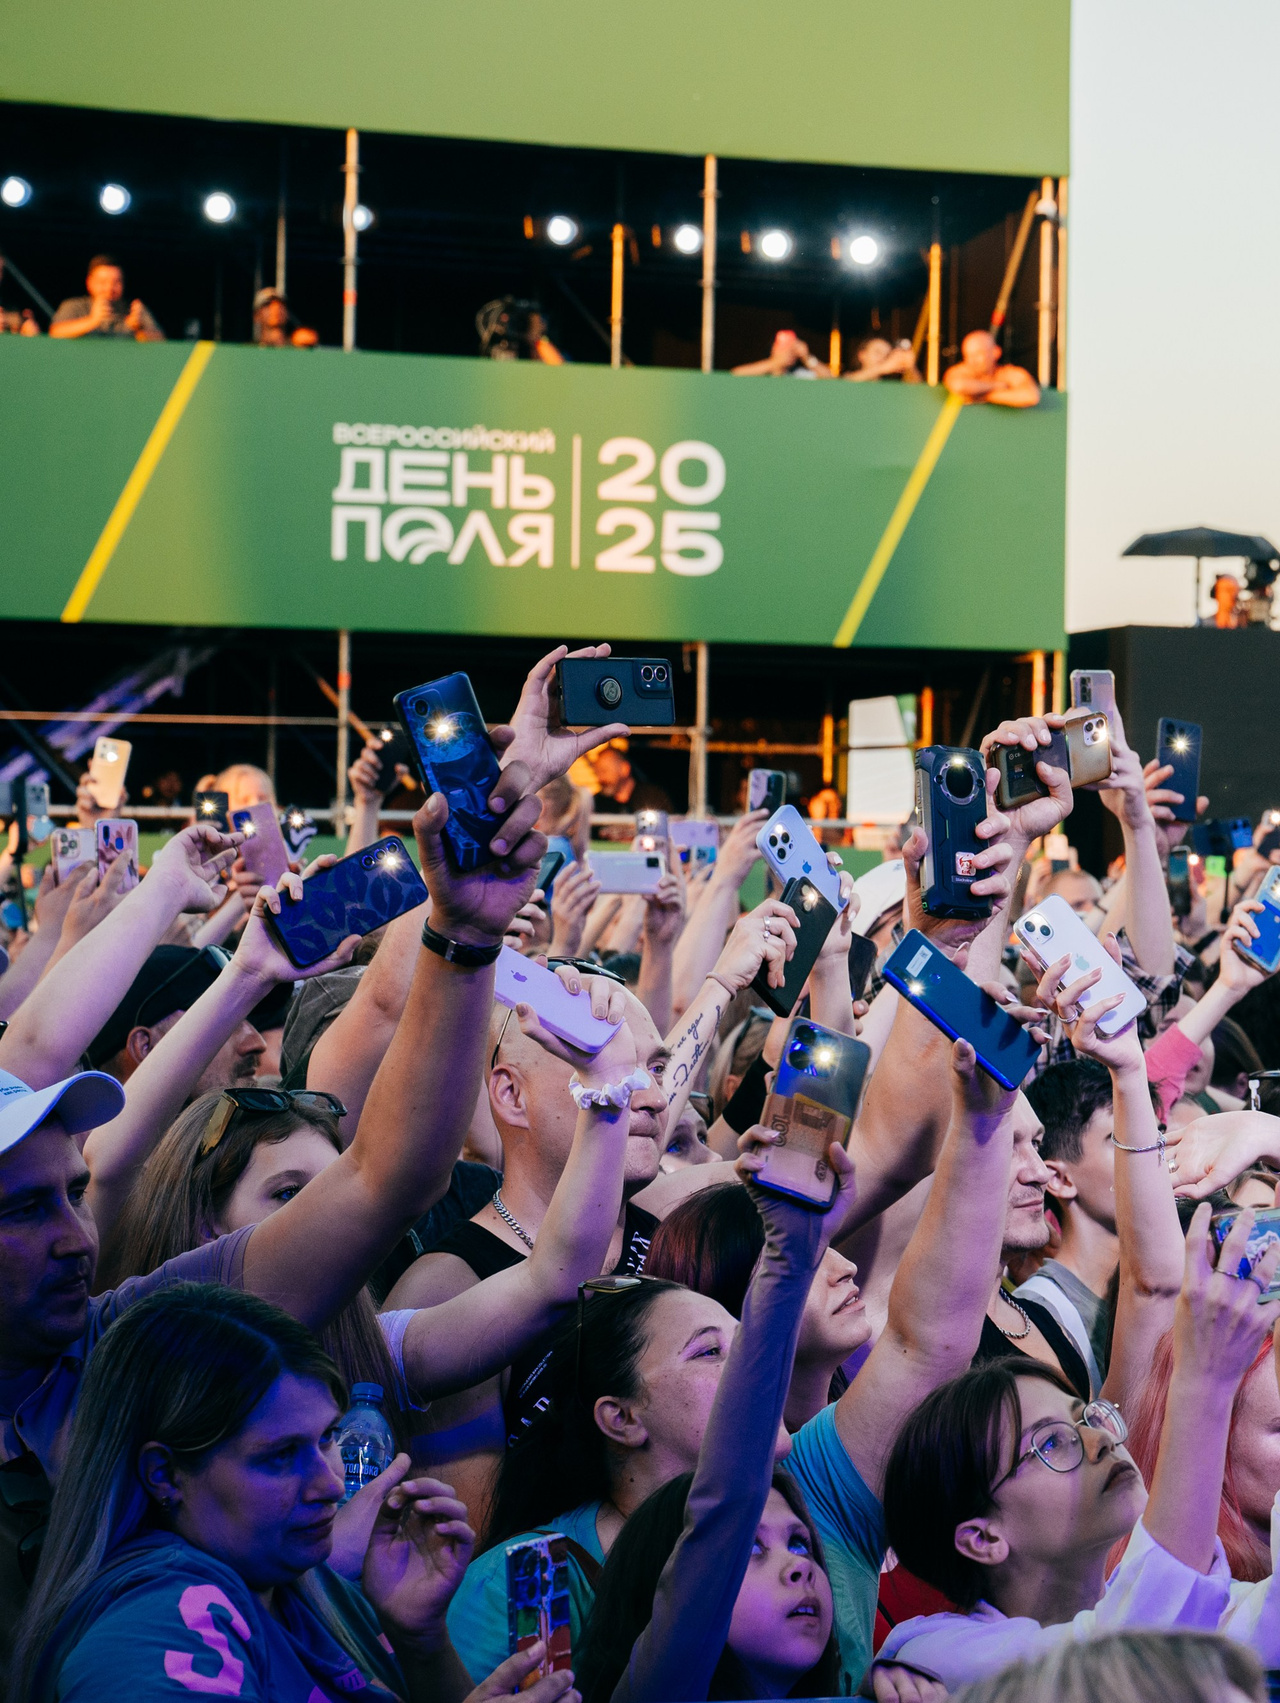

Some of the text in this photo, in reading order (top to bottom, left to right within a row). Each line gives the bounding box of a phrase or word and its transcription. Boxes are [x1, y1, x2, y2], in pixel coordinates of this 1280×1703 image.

[332, 422, 556, 454] ВСЕРОССИЙСКИЙ
[332, 446, 556, 510] ДЕНЬ
[597, 436, 726, 505] 20
[331, 505, 555, 569] ПОЛЯ
[594, 507, 725, 576] 25
